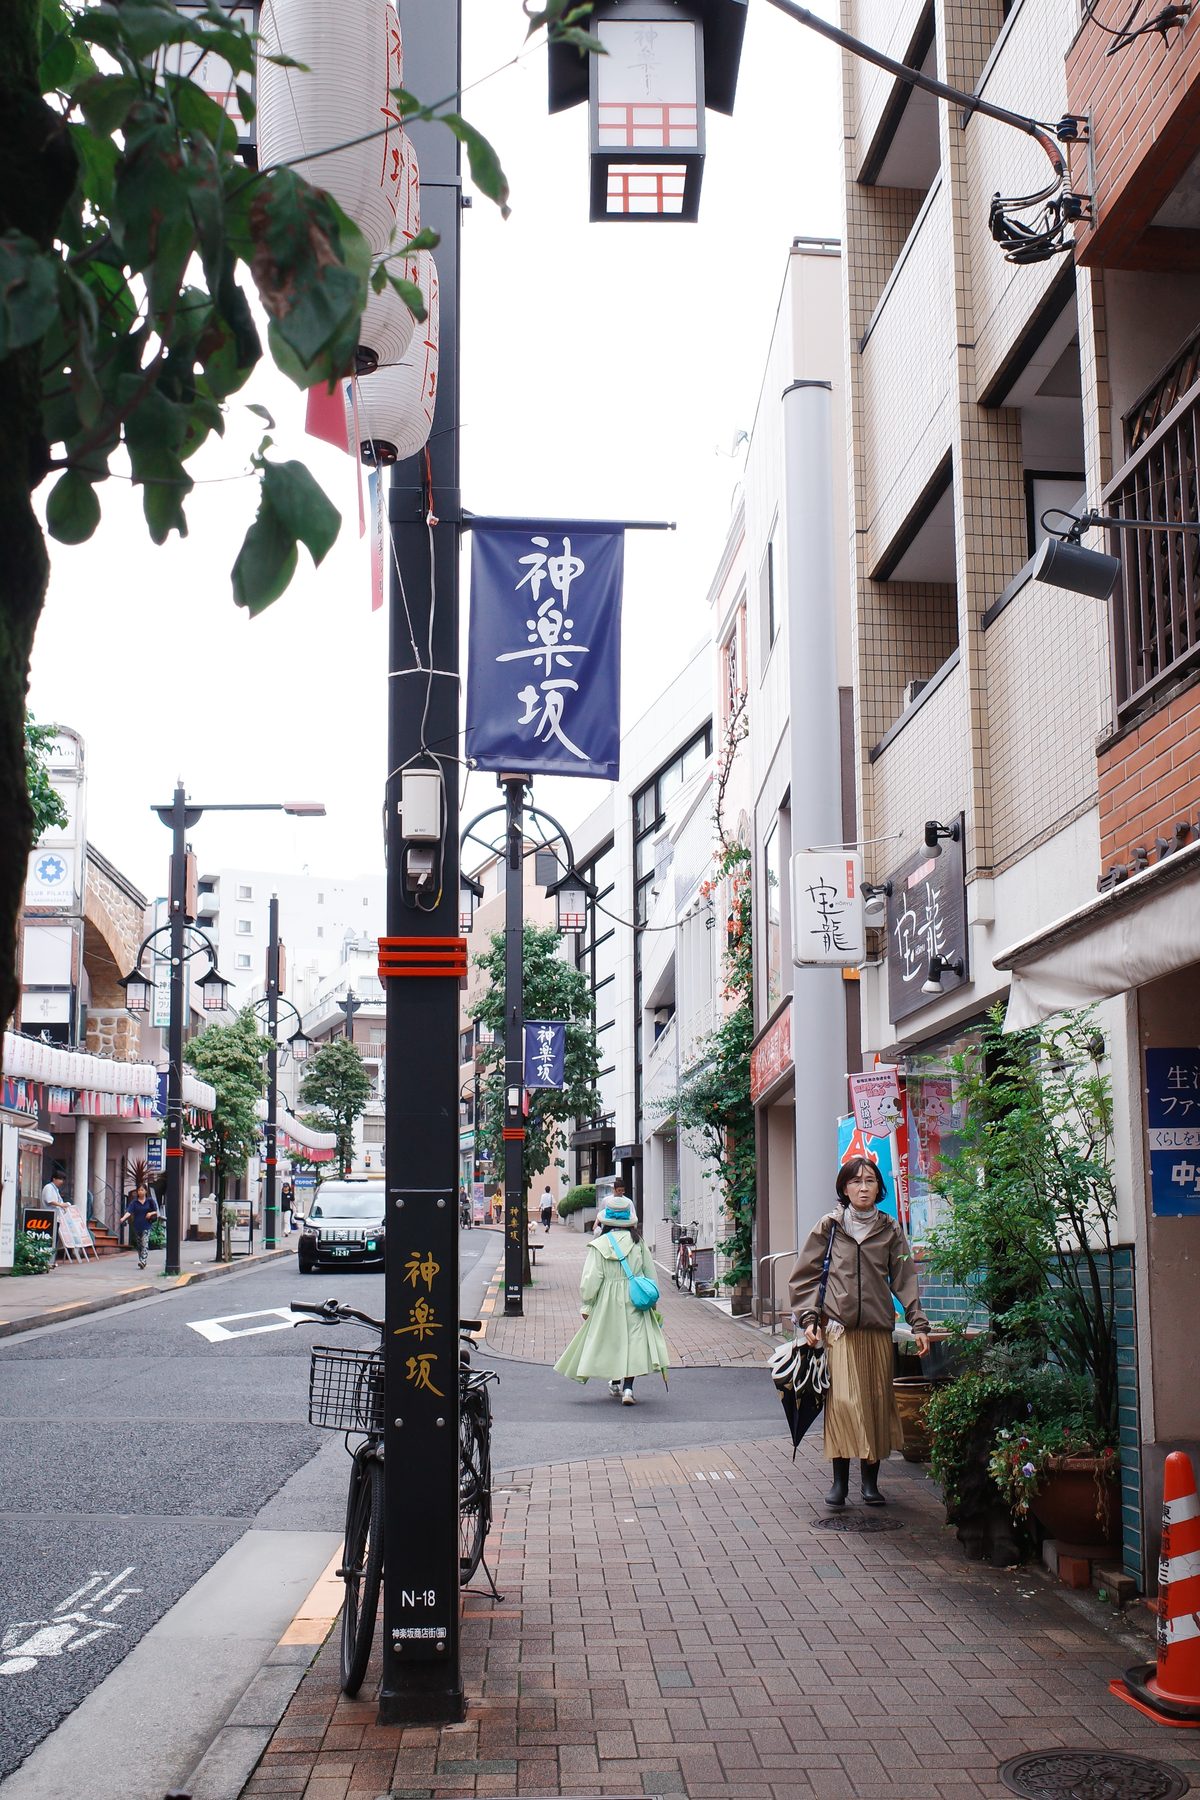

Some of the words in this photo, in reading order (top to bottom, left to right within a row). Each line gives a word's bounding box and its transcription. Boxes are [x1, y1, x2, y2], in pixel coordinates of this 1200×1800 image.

[495, 536, 592, 760] 神楽坂
[804, 876, 858, 954] 宝龍
[532, 1026, 556, 1085] 神楽坂
[27, 1219, 50, 1229] au
[27, 1230, 51, 1241] Style
[507, 1206, 520, 1242] 神楽坂
[393, 1251, 445, 1397] 神楽坂
[401, 1590, 436, 1607] N-18
